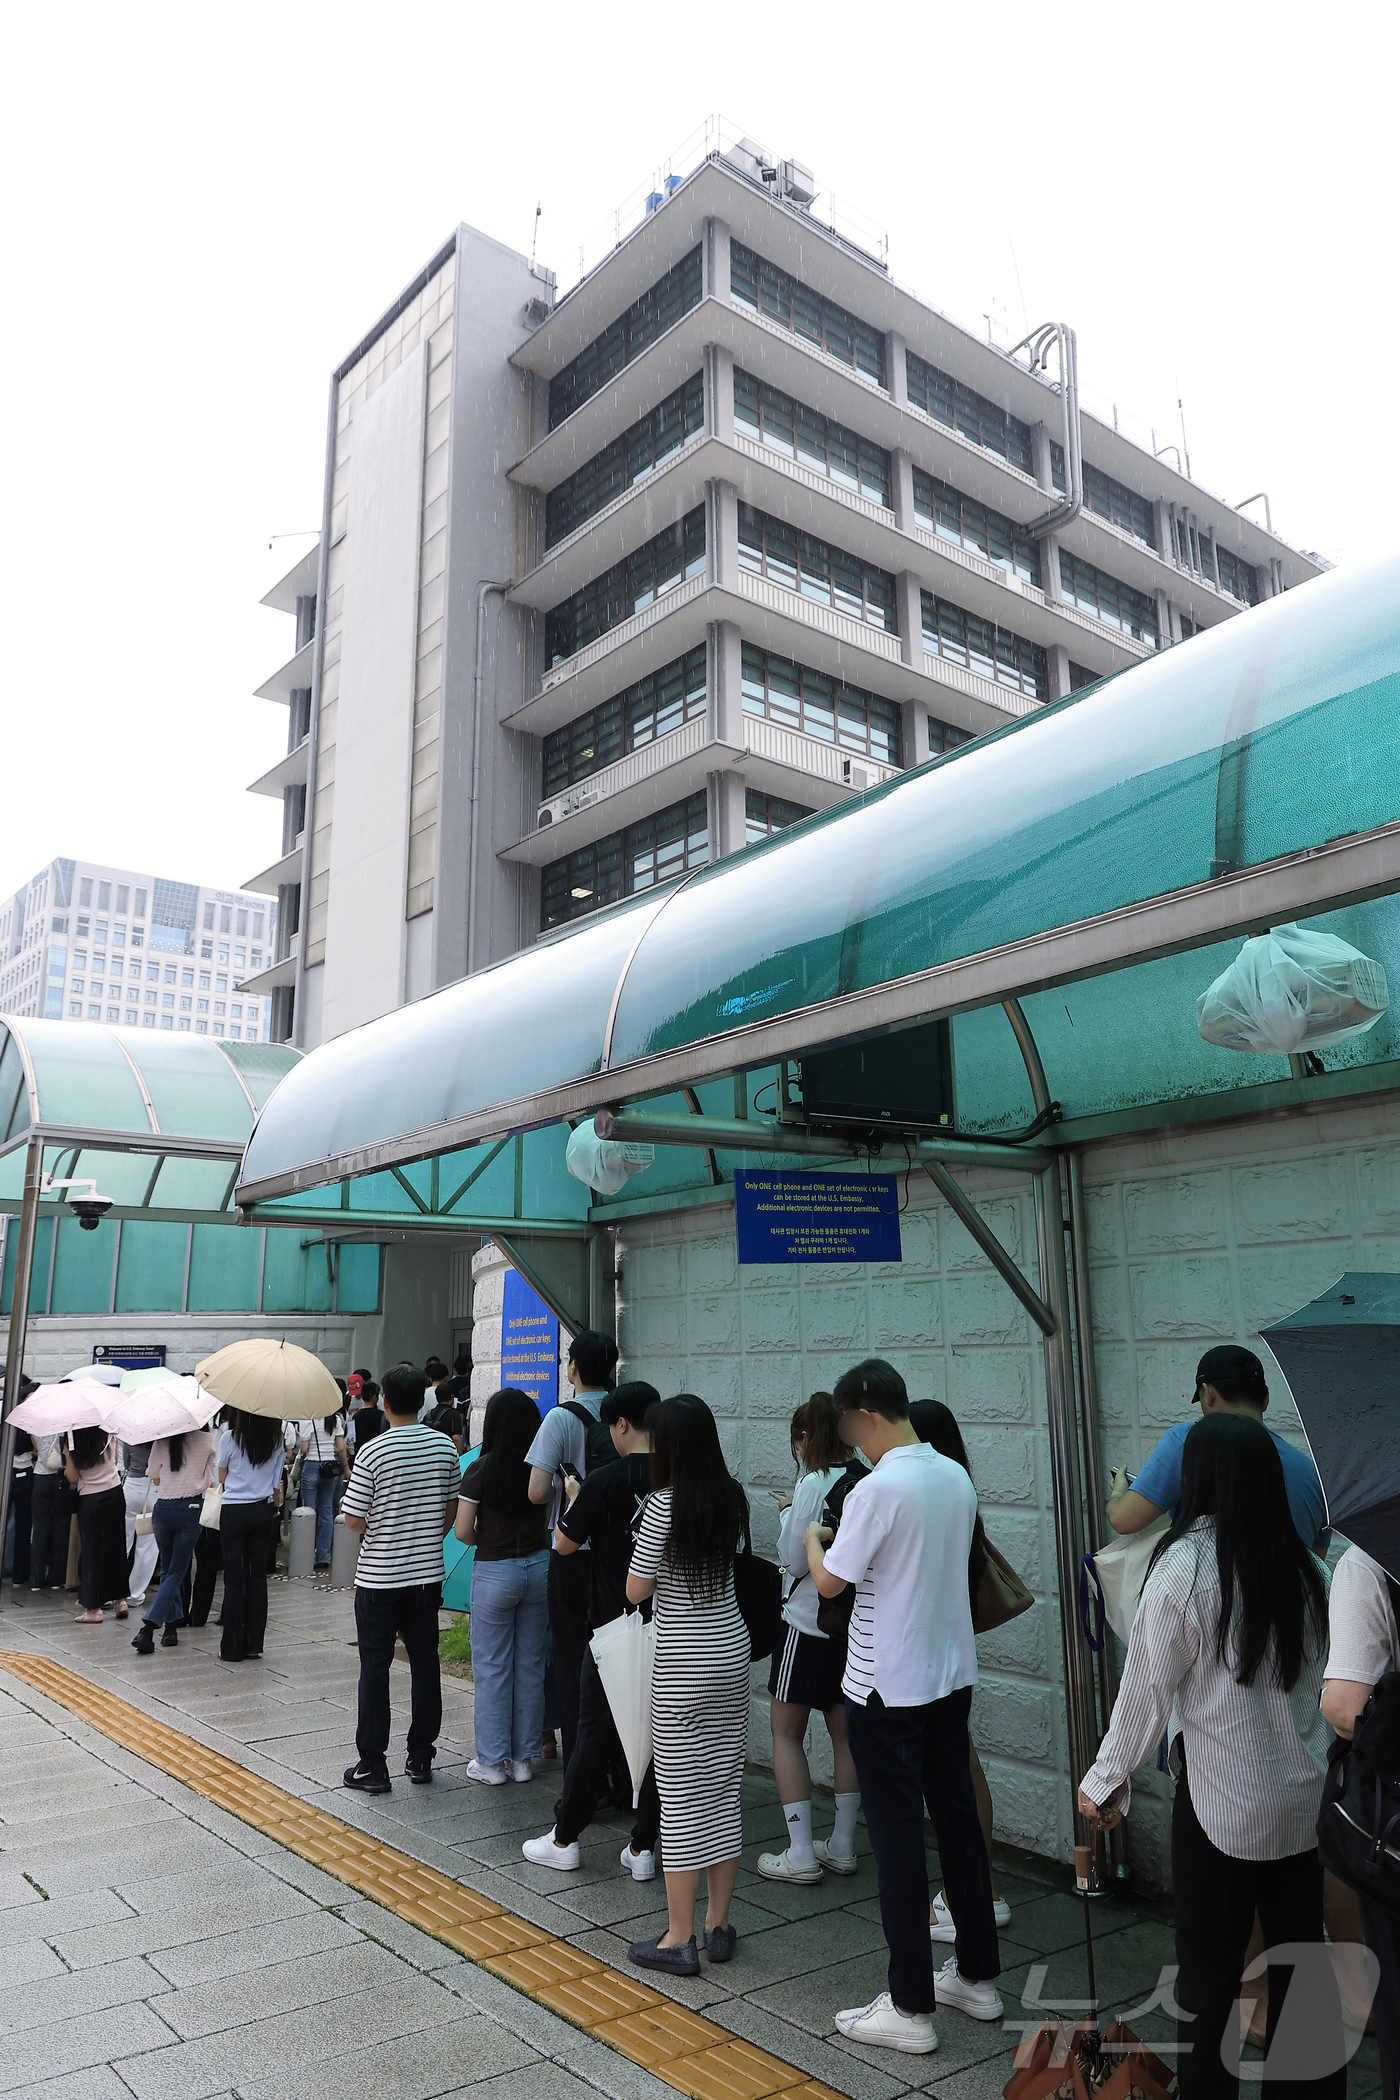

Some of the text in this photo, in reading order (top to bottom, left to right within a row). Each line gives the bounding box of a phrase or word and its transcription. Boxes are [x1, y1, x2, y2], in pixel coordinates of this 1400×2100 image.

[215, 892, 265, 910] 외교부 MOFA
[745, 1182, 758, 1190] Only
[783, 1183, 800, 1191] phone
[842, 1184, 867, 1192] electronic
[877, 1185, 889, 1193] keys
[785, 1193, 792, 1201] be
[840, 1195, 864, 1203] Embassy.
[786, 1204, 812, 1212] electronic
[528, 1316, 539, 1327] phone
[521, 1334, 536, 1344] electronic
[542, 1333, 551, 1344] keys
[520, 1371, 535, 1380] electronic
[536, 1370, 550, 1380] devices
